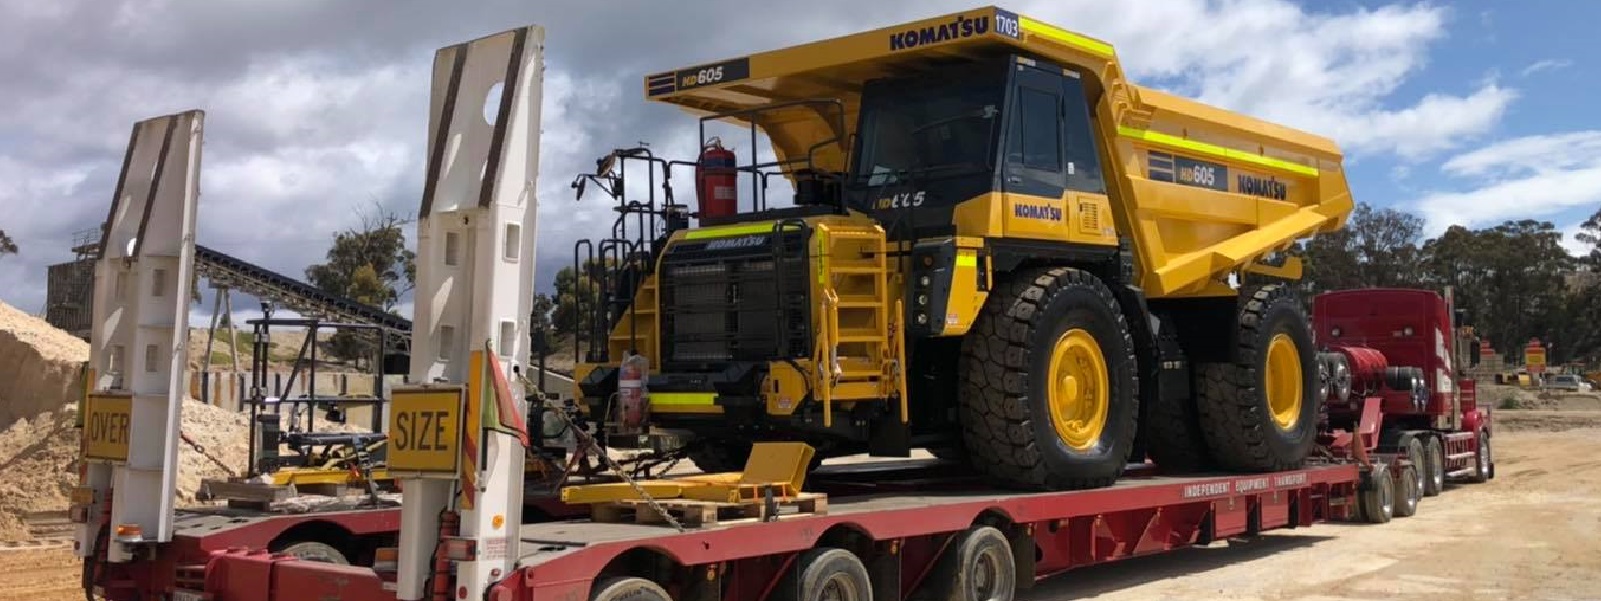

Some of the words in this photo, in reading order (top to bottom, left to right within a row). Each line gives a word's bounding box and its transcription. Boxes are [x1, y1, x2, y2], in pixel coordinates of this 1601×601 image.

[889, 15, 989, 51] KOMATSU
[995, 14, 1018, 37] 1703
[1237, 175, 1287, 200] KOMATSU
[1015, 203, 1062, 221] KOMATSU
[706, 236, 765, 250] KOMATSU
[92, 411, 130, 444] OVER
[395, 411, 449, 451] SIZE
[1184, 482, 1230, 498] INDEPENDENT
[1236, 477, 1269, 493] EQUIPMENT
